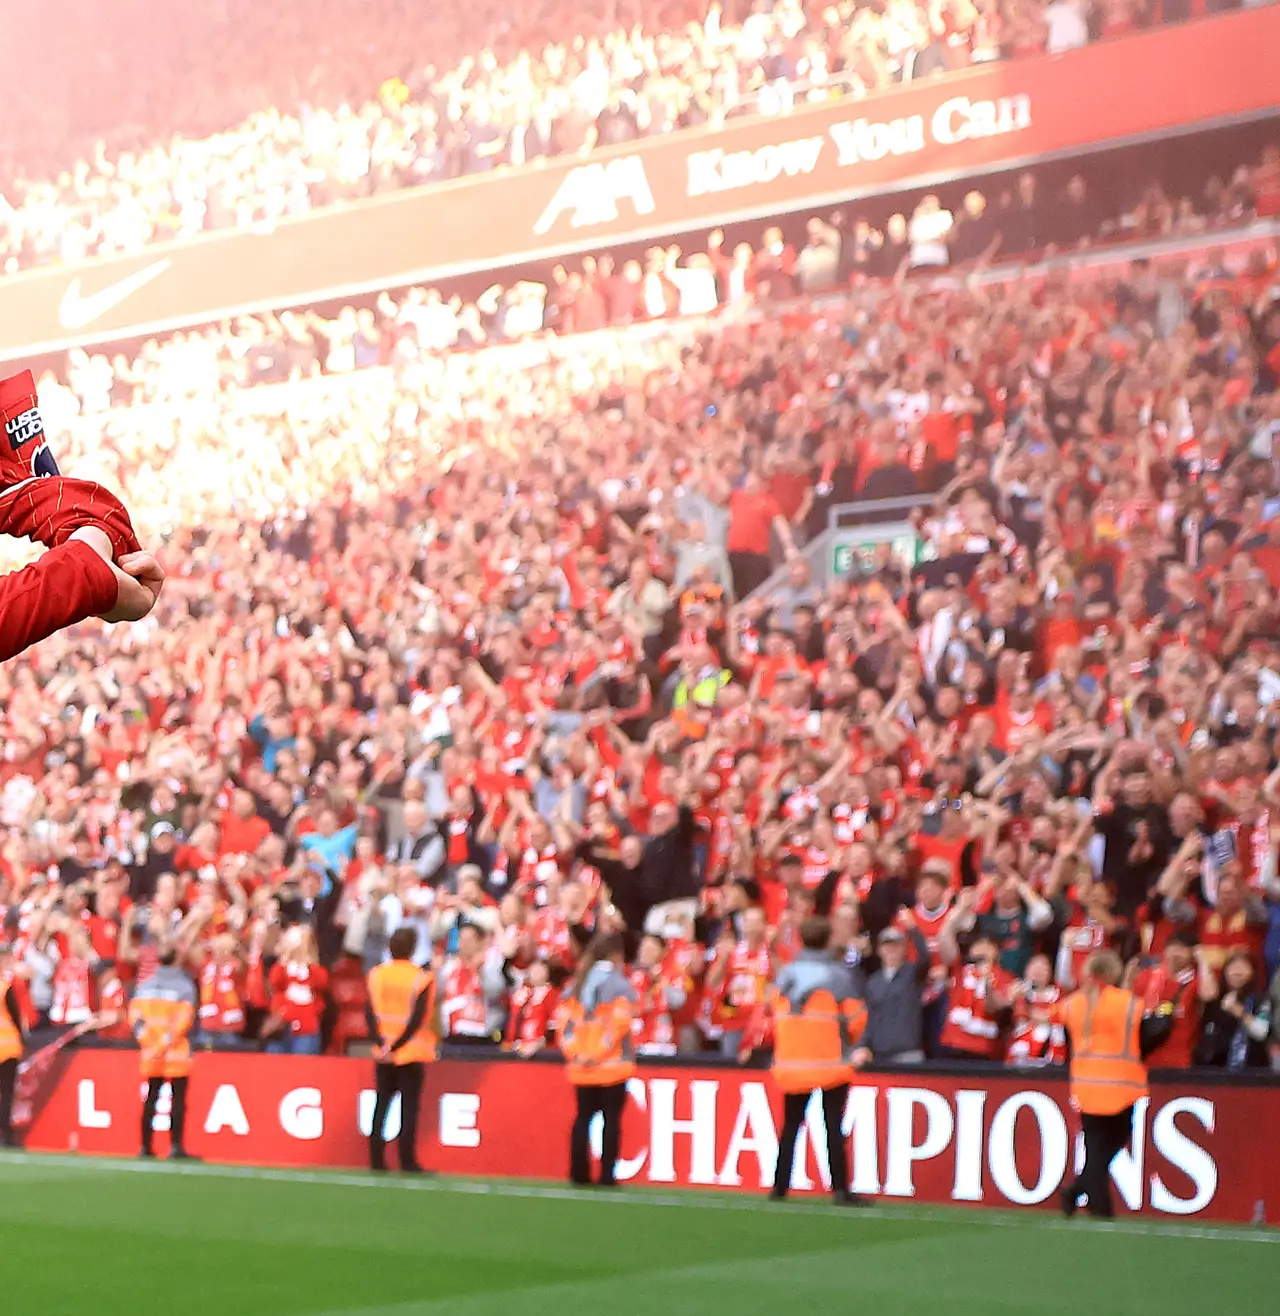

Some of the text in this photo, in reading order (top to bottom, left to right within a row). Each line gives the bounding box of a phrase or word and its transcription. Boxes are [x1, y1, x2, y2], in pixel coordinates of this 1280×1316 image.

[687, 136, 824, 197] Know
[828, 114, 925, 167] You
[931, 94, 1032, 144] Can
